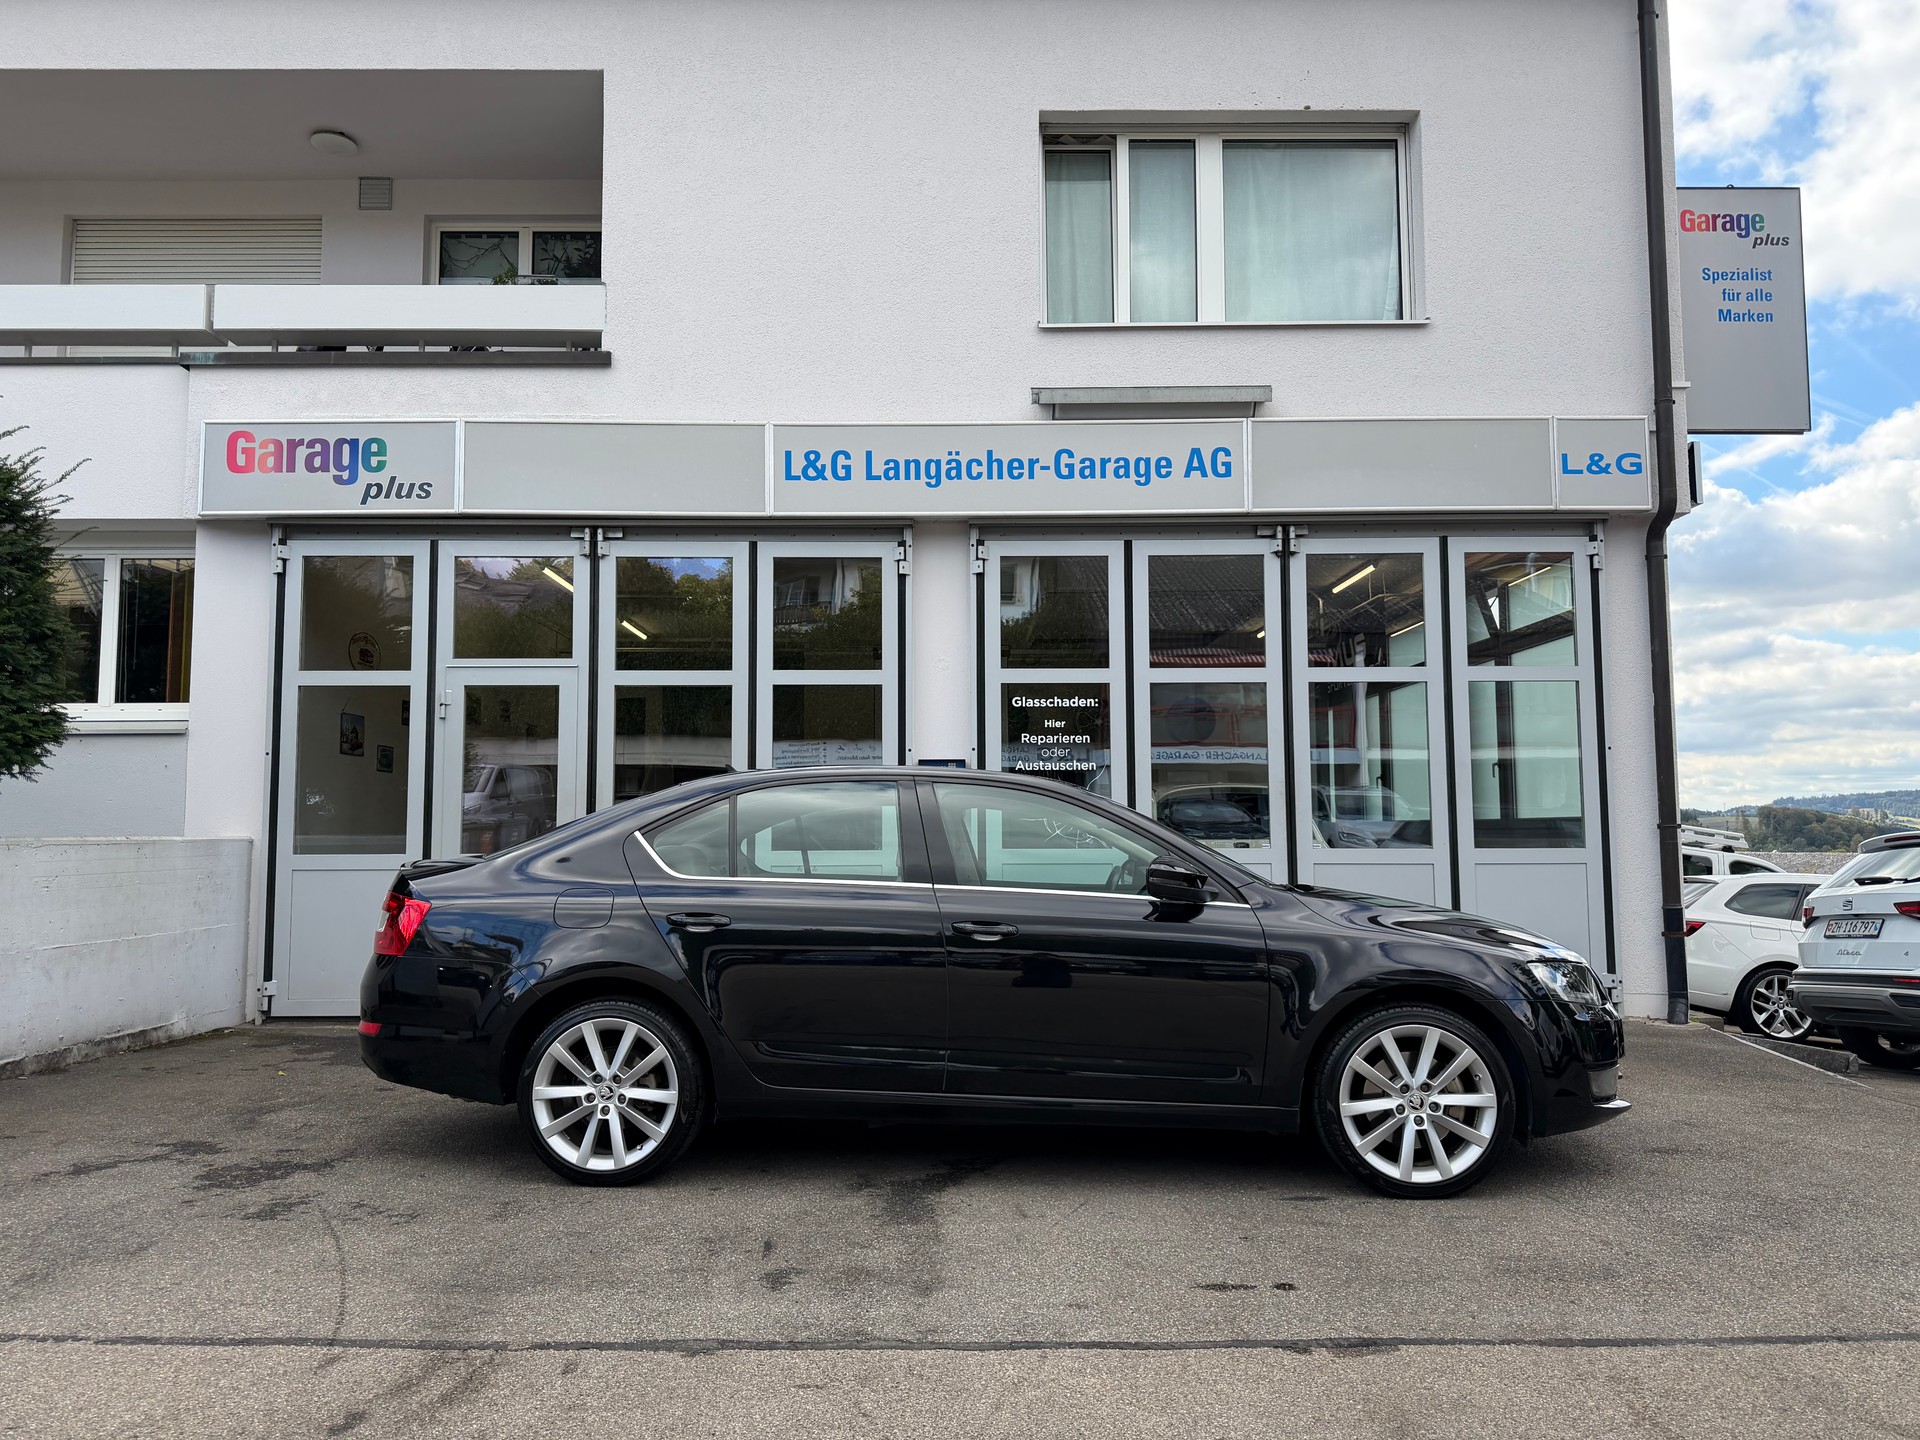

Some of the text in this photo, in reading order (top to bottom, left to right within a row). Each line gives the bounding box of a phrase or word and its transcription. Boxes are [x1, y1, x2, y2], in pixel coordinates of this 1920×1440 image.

[1679, 209, 1765, 239] Garage
[1752, 233, 1790, 249] plus
[1701, 267, 1773, 284] Spezialist
[1721, 288, 1773, 302] für alle
[1717, 308, 1774, 323] Marken
[226, 430, 387, 485] Garage
[1561, 452, 1643, 475] L&G
[784, 446, 1233, 489] L&G Langächer-Garage AG
[360, 475, 433, 505] plus
[1011, 696, 1099, 708] Glasschaden:
[1044, 719, 1066, 728] Hier
[1021, 732, 1091, 745] Reparieren
[1041, 746, 1071, 757] oder
[1015, 760, 1097, 772] Austauschen
